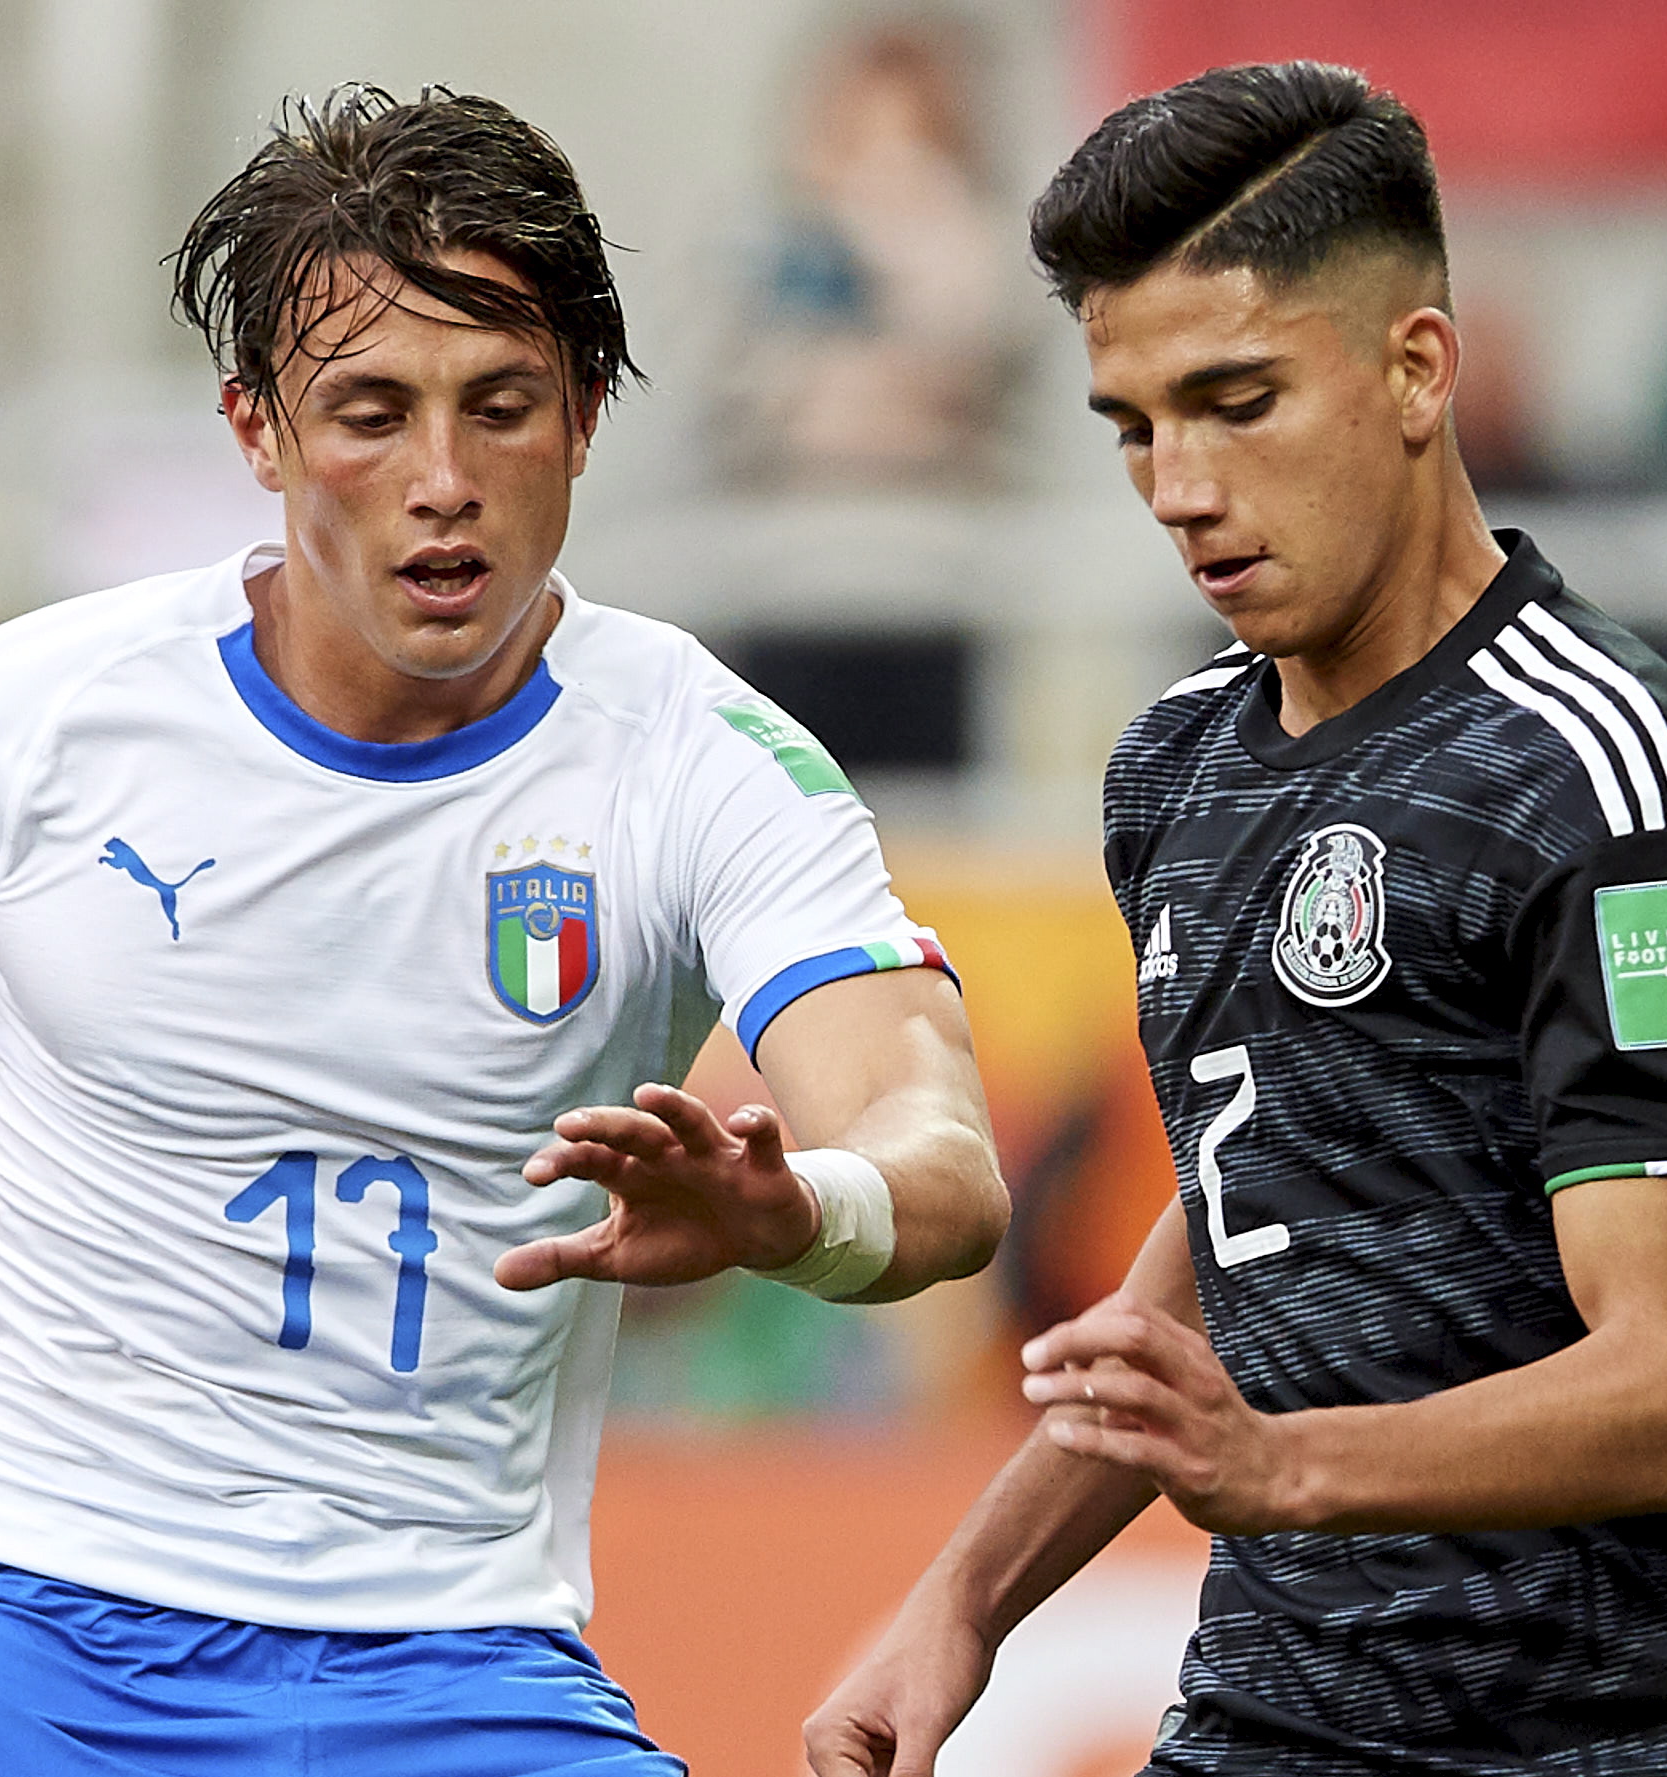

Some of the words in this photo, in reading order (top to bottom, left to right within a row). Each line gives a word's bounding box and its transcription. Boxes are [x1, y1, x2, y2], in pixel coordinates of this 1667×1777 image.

[496, 878, 587, 905] ITALIA
[224, 1150, 438, 1373] 17
[1190, 1044, 1291, 1269] 2
